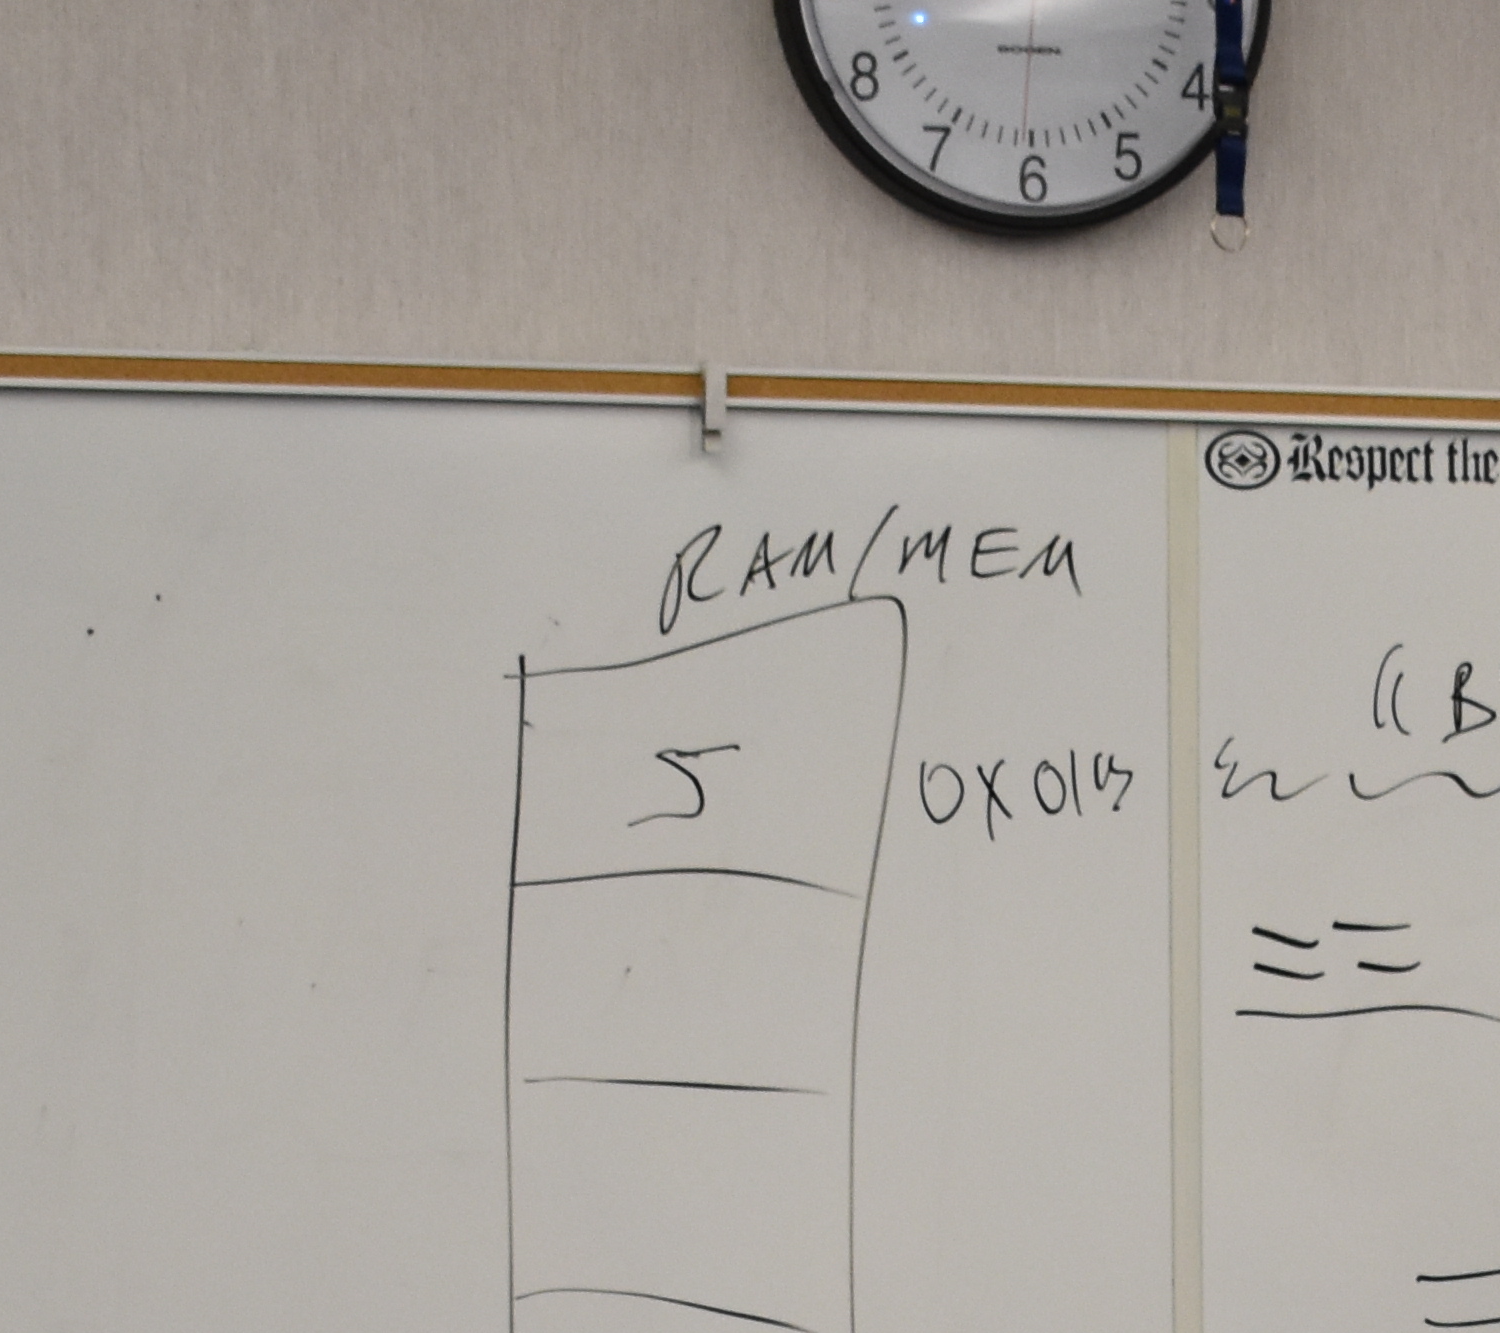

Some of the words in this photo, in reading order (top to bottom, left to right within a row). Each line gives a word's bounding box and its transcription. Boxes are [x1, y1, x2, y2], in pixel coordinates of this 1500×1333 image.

[849, 51, 879, 101] 8
[1181, 63, 1211, 111] 4
[922, 126, 953, 172] 7
[1114, 133, 1143, 180] 5
[1019, 155, 1048, 201] 6
[1287, 431, 1438, 489] Respect
[627, 743, 742, 827] 5
